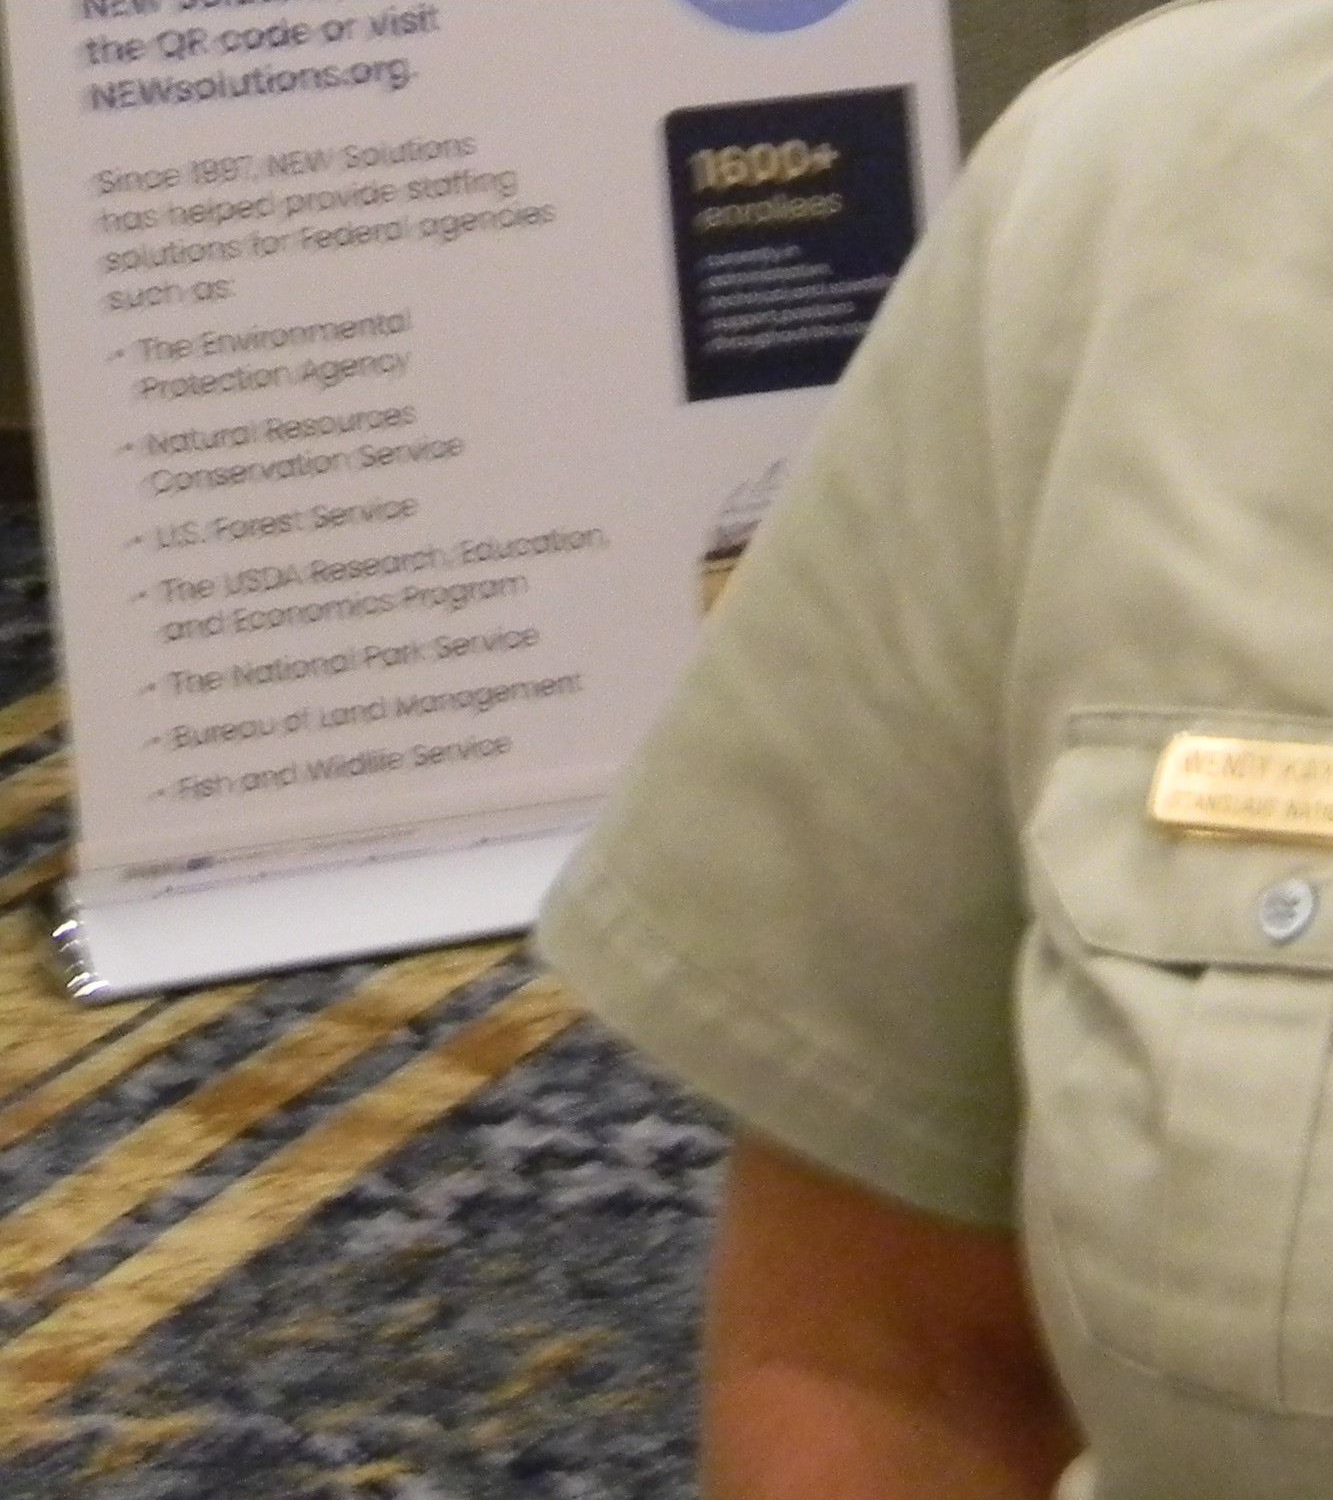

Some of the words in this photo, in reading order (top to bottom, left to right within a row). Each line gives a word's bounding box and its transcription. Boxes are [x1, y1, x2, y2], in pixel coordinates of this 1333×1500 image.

[86, 35, 144, 65] the
[157, 28, 209, 60] QR
[219, 18, 309, 53] code
[323, 18, 354, 43] or
[366, 3, 441, 39] visit
[96, 166, 179, 195] Since
[268, 150, 332, 176] NEW
[345, 133, 476, 168] Solutions
[688, 138, 840, 192] 1600+
[101, 208, 157, 234] has
[169, 192, 273, 229] helped
[285, 181, 396, 218] provide
[408, 167, 518, 203] staffing
[104, 237, 241, 273] solutions
[252, 229, 288, 256] for
[302, 218, 405, 250] Federal
[420, 203, 557, 241] agencies
[108, 283, 182, 310] such
[138, 337, 192, 363] The
[203, 309, 413, 356] Environmental
[141, 363, 293, 398] Protection
[302, 351, 410, 389] Agency
[148, 424, 258, 456] Natural
[267, 405, 416, 443] Resources
[147, 453, 348, 497] Conservation
[359, 435, 466, 468] Service
[216, 509, 300, 540] Forest
[313, 497, 418, 529] Service
[161, 578, 213, 605] The
[224, 567, 300, 595] USDA
[164, 615, 223, 644] and
[234, 592, 396, 633] Economics
[404, 575, 528, 612] Program
[171, 669, 220, 696] The
[232, 650, 355, 686] National
[365, 640, 424, 671] Park
[434, 623, 540, 658] Service
[171, 722, 275, 751] Bureau
[282, 712, 310, 736] of
[320, 697, 386, 729] Land
[396, 671, 582, 719] Management
[178, 772, 238, 800] Fish
[245, 764, 297, 793] and
[308, 744, 402, 783] Wildlife
[413, 733, 512, 768] Service
